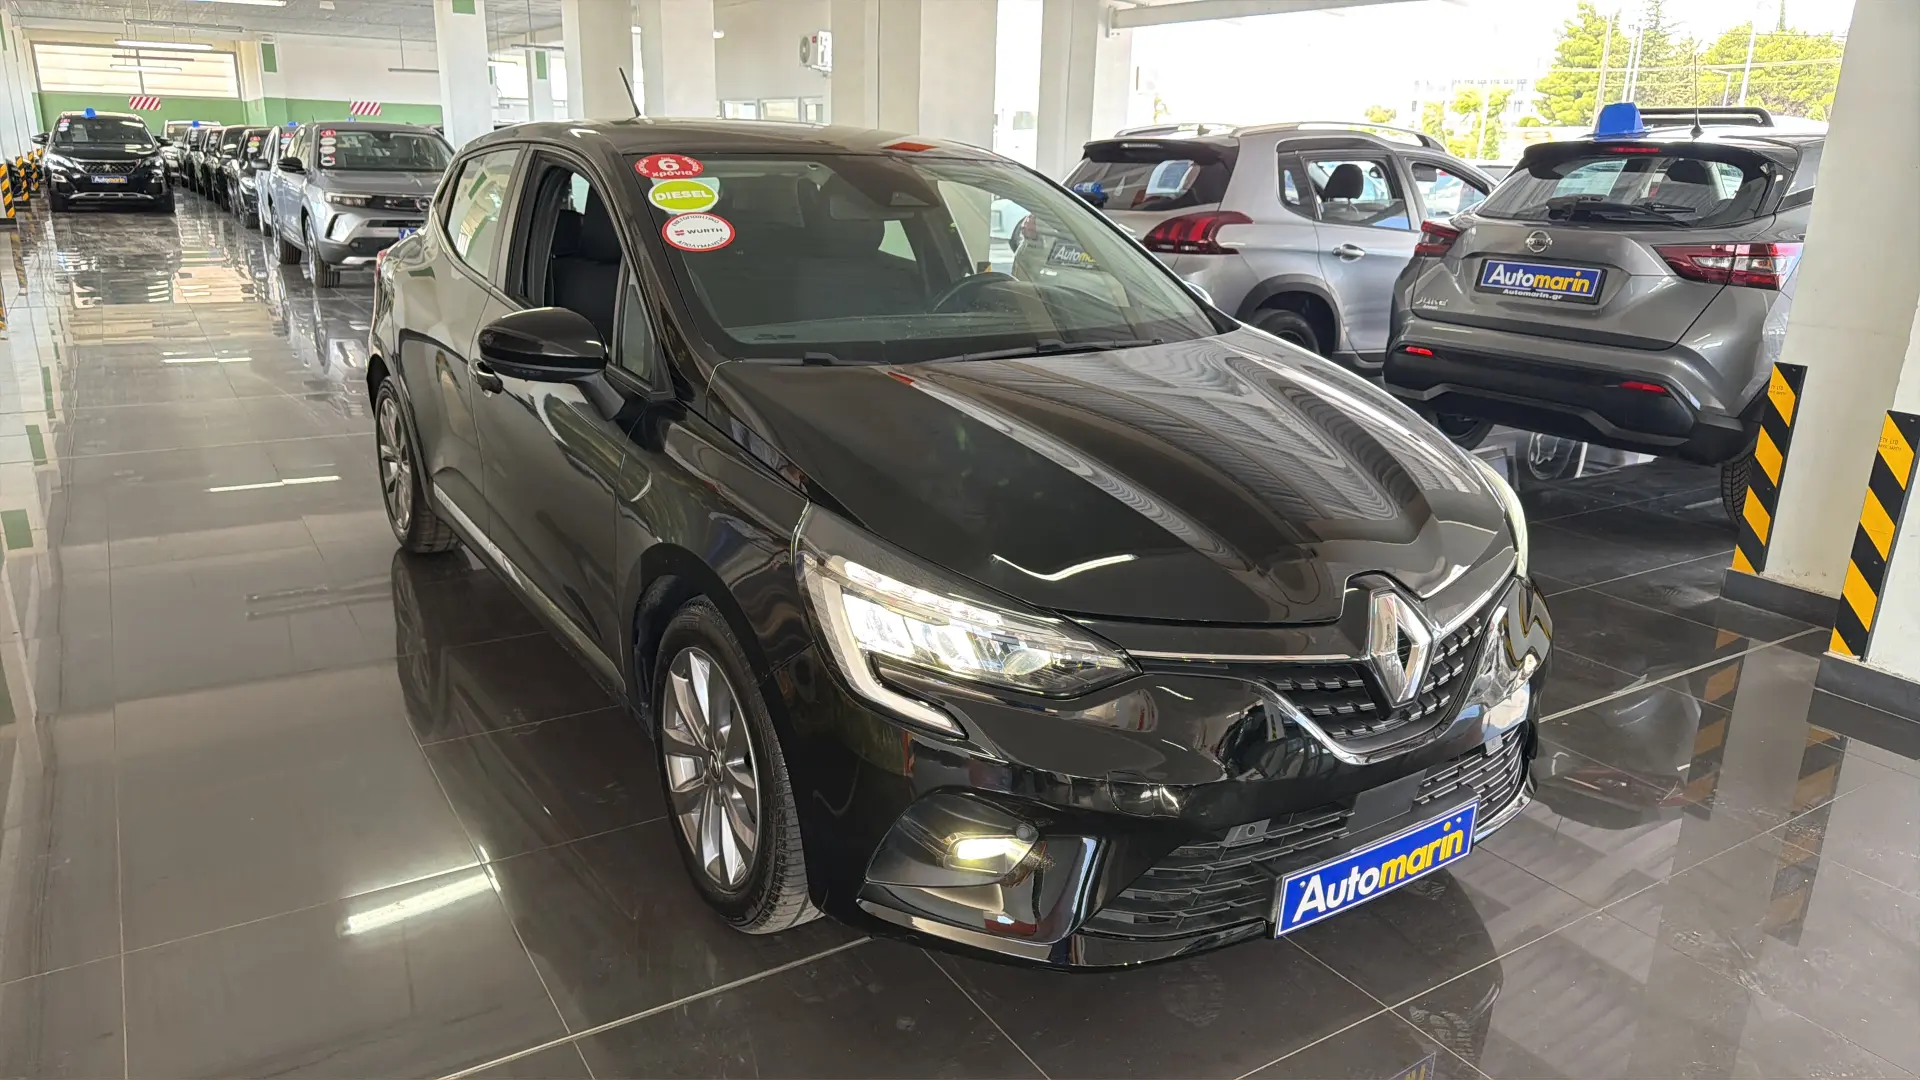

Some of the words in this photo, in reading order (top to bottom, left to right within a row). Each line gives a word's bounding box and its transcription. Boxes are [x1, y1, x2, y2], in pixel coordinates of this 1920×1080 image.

[658, 158, 680, 171] 6
[652, 170, 693, 178] χρόνια
[655, 190, 713, 201] DIESEL
[1488, 264, 1590, 293] Automarin
[1503, 288, 1563, 300] Automarin.gr
[1292, 821, 1464, 923] Automarin
